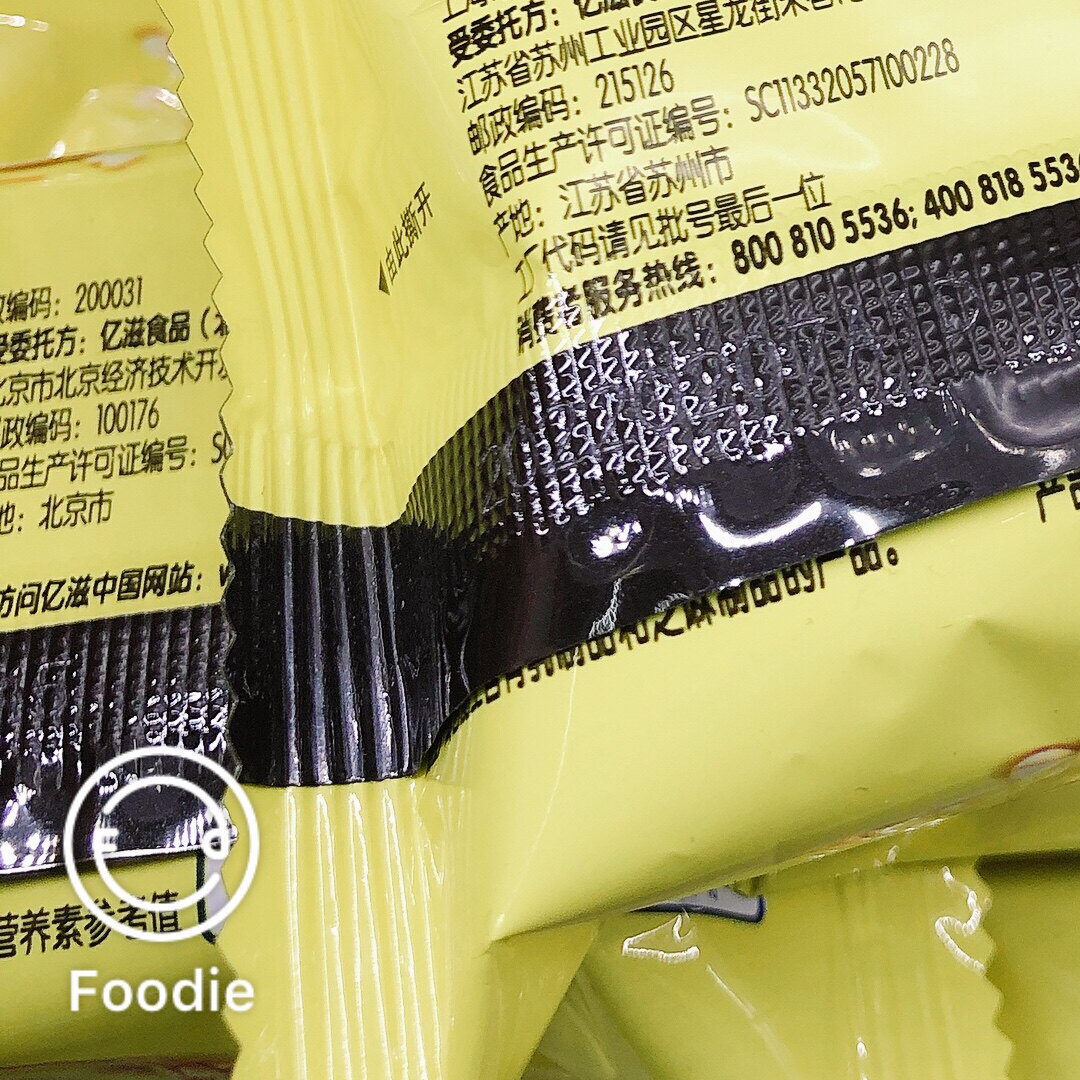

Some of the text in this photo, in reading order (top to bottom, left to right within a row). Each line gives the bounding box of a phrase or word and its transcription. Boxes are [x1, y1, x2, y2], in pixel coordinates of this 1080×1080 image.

[595, 58, 675, 111] 215126
[744, 37, 961, 122] SC11332057100228
[558, 145, 734, 220] 江苏省苏州市
[731, 231, 784, 276] 800
[790, 214, 836, 254] 810
[843, 197, 918, 243] 5536;
[924, 180, 973, 221] 400
[978, 169, 1024, 205] 818
[0, 277, 143, 324] 编码： 200031
[97, 397, 160, 436] 100176
[38, 489, 115, 531] 北京市
